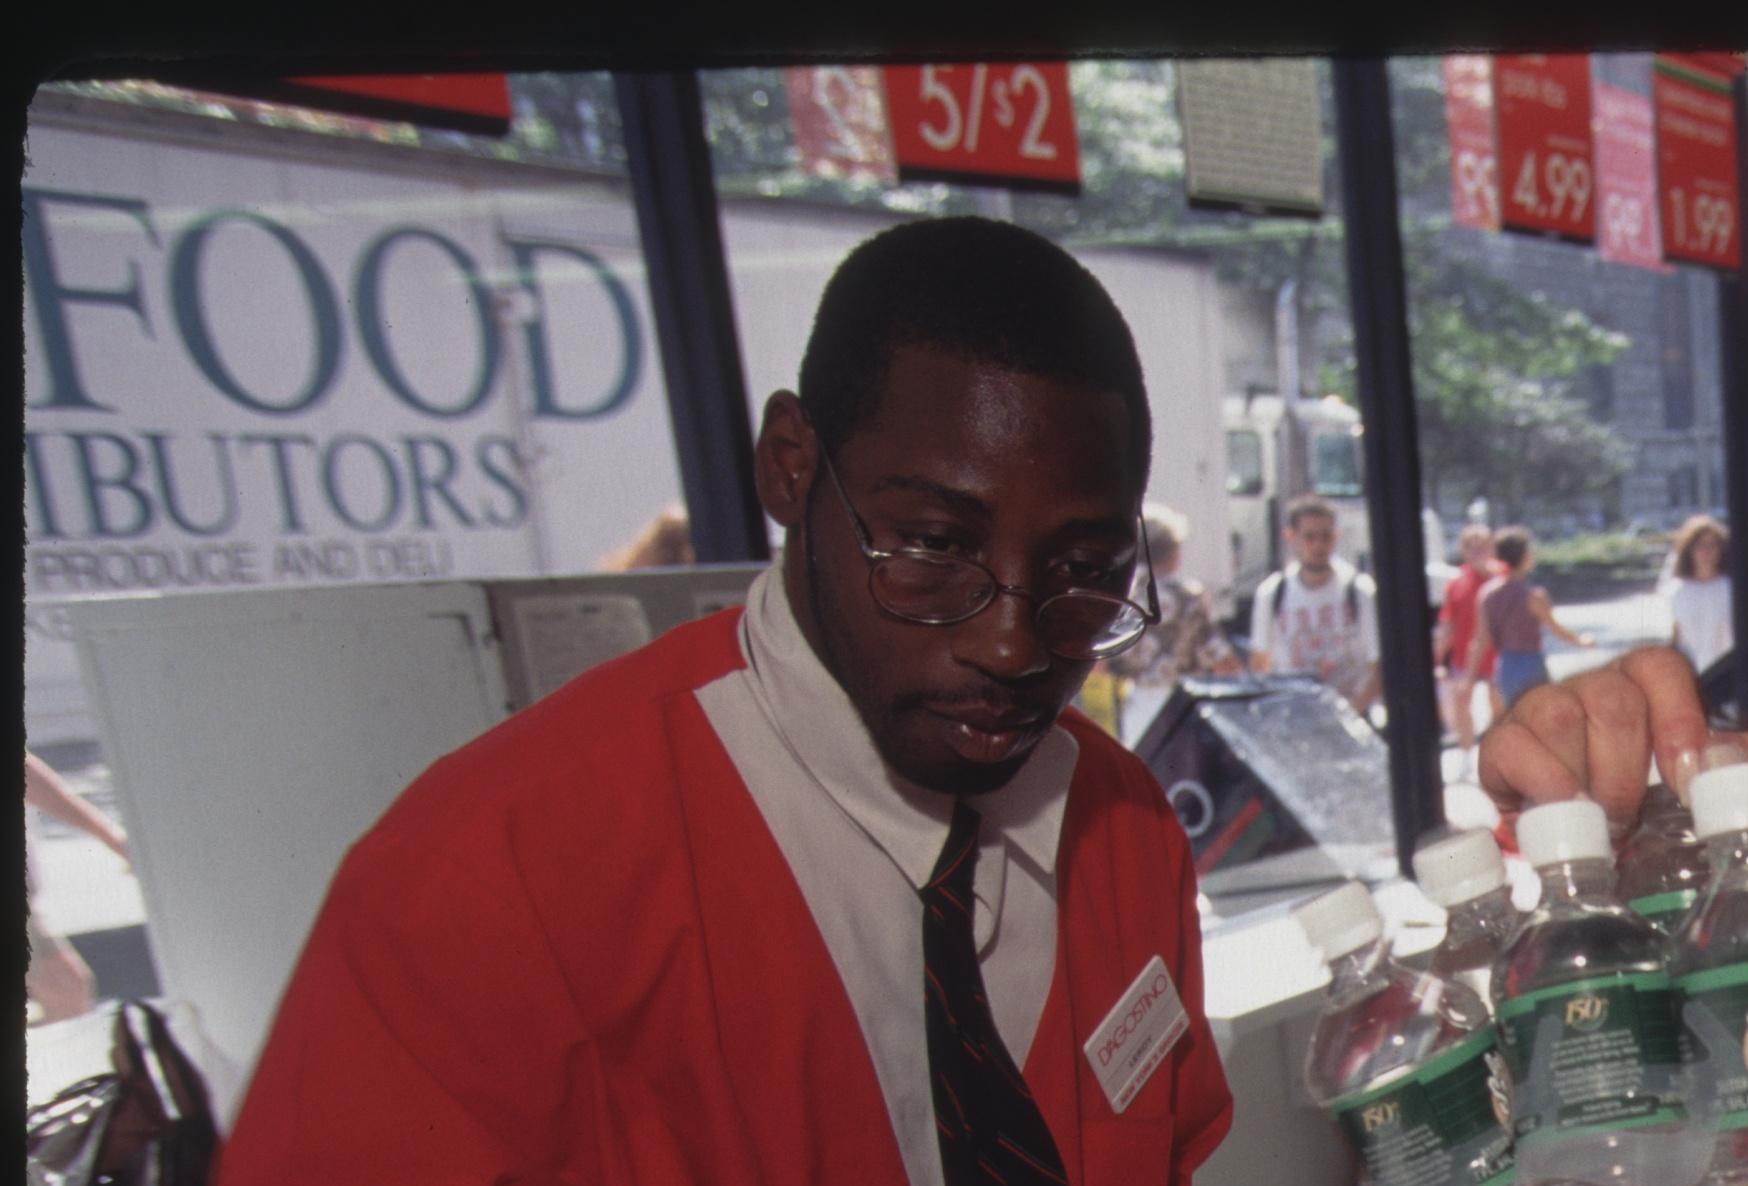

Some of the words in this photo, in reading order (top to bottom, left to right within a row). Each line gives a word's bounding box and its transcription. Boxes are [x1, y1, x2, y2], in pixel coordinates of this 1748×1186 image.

[1512, 149, 1592, 223] 4.99
[1670, 187, 1735, 257] 1.99
[22, 186, 645, 420] FOOD
[32, 542, 258, 591] PRODUCE
[273, 539, 358, 582] AND
